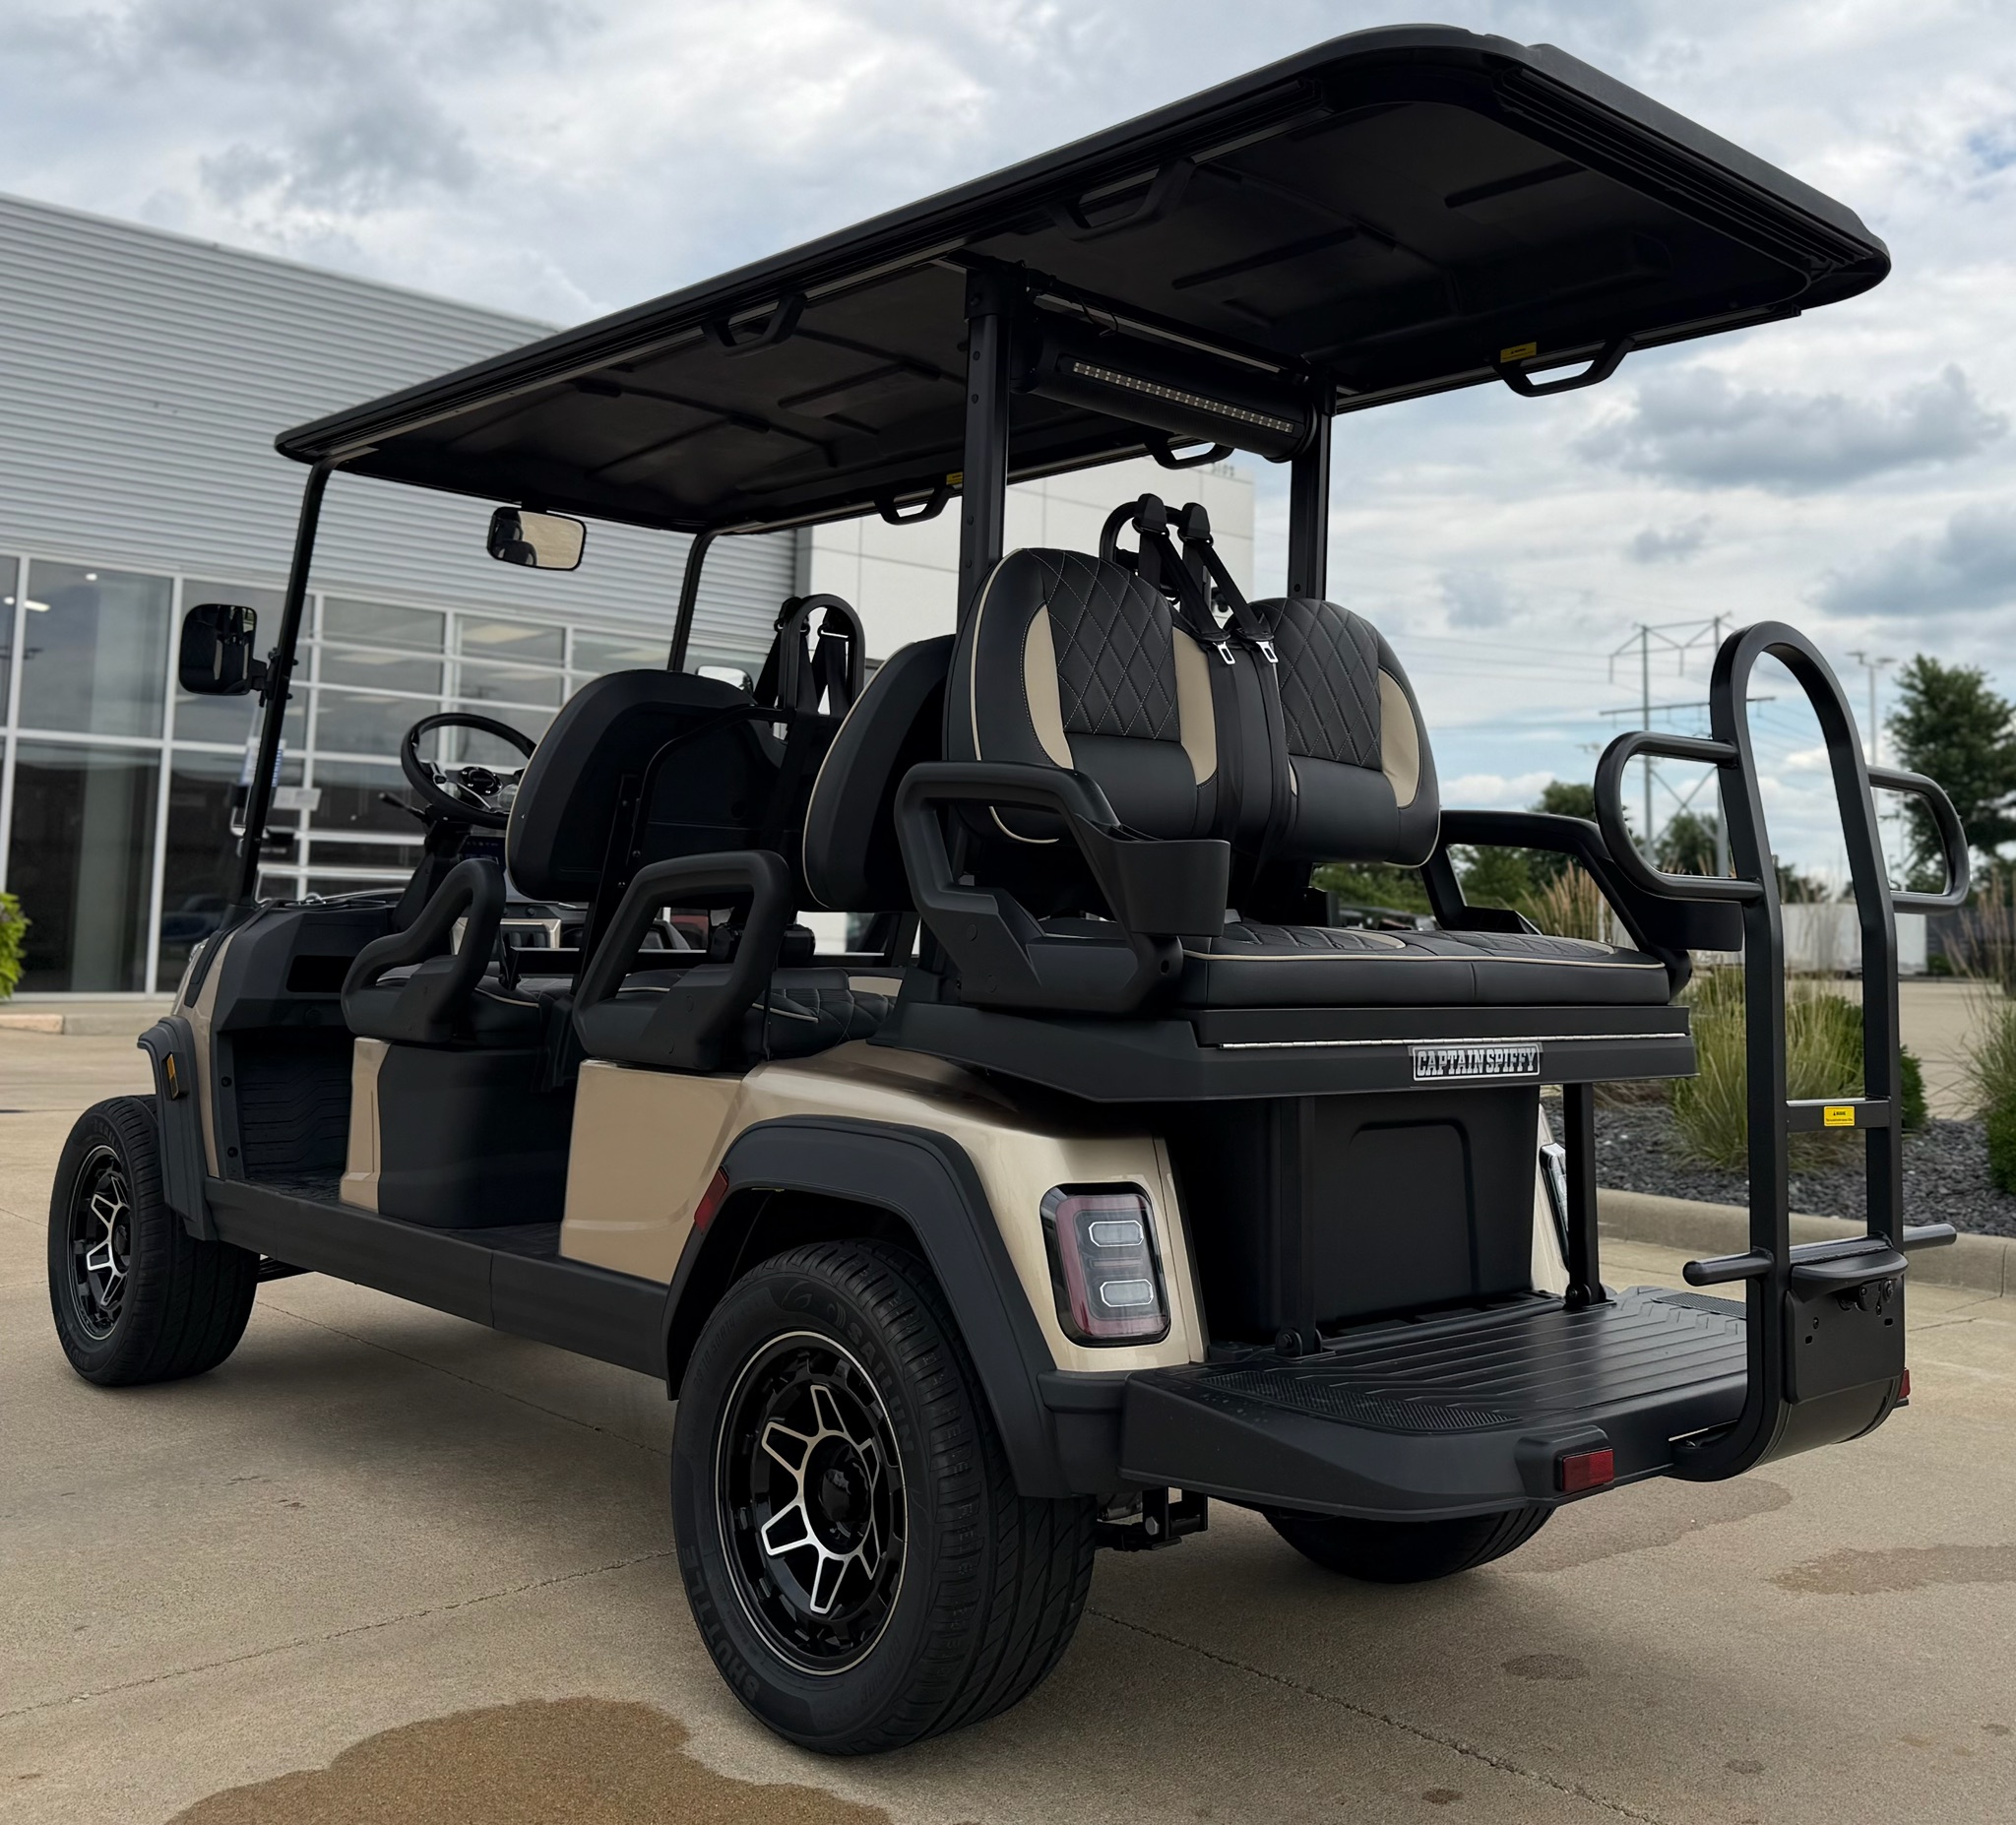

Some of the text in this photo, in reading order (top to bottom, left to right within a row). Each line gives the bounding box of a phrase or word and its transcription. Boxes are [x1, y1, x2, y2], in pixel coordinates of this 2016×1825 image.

[1418, 1047, 1536, 1076] CAPTAIN SPIFFY
[681, 1544, 760, 1702] SHUTTLE
